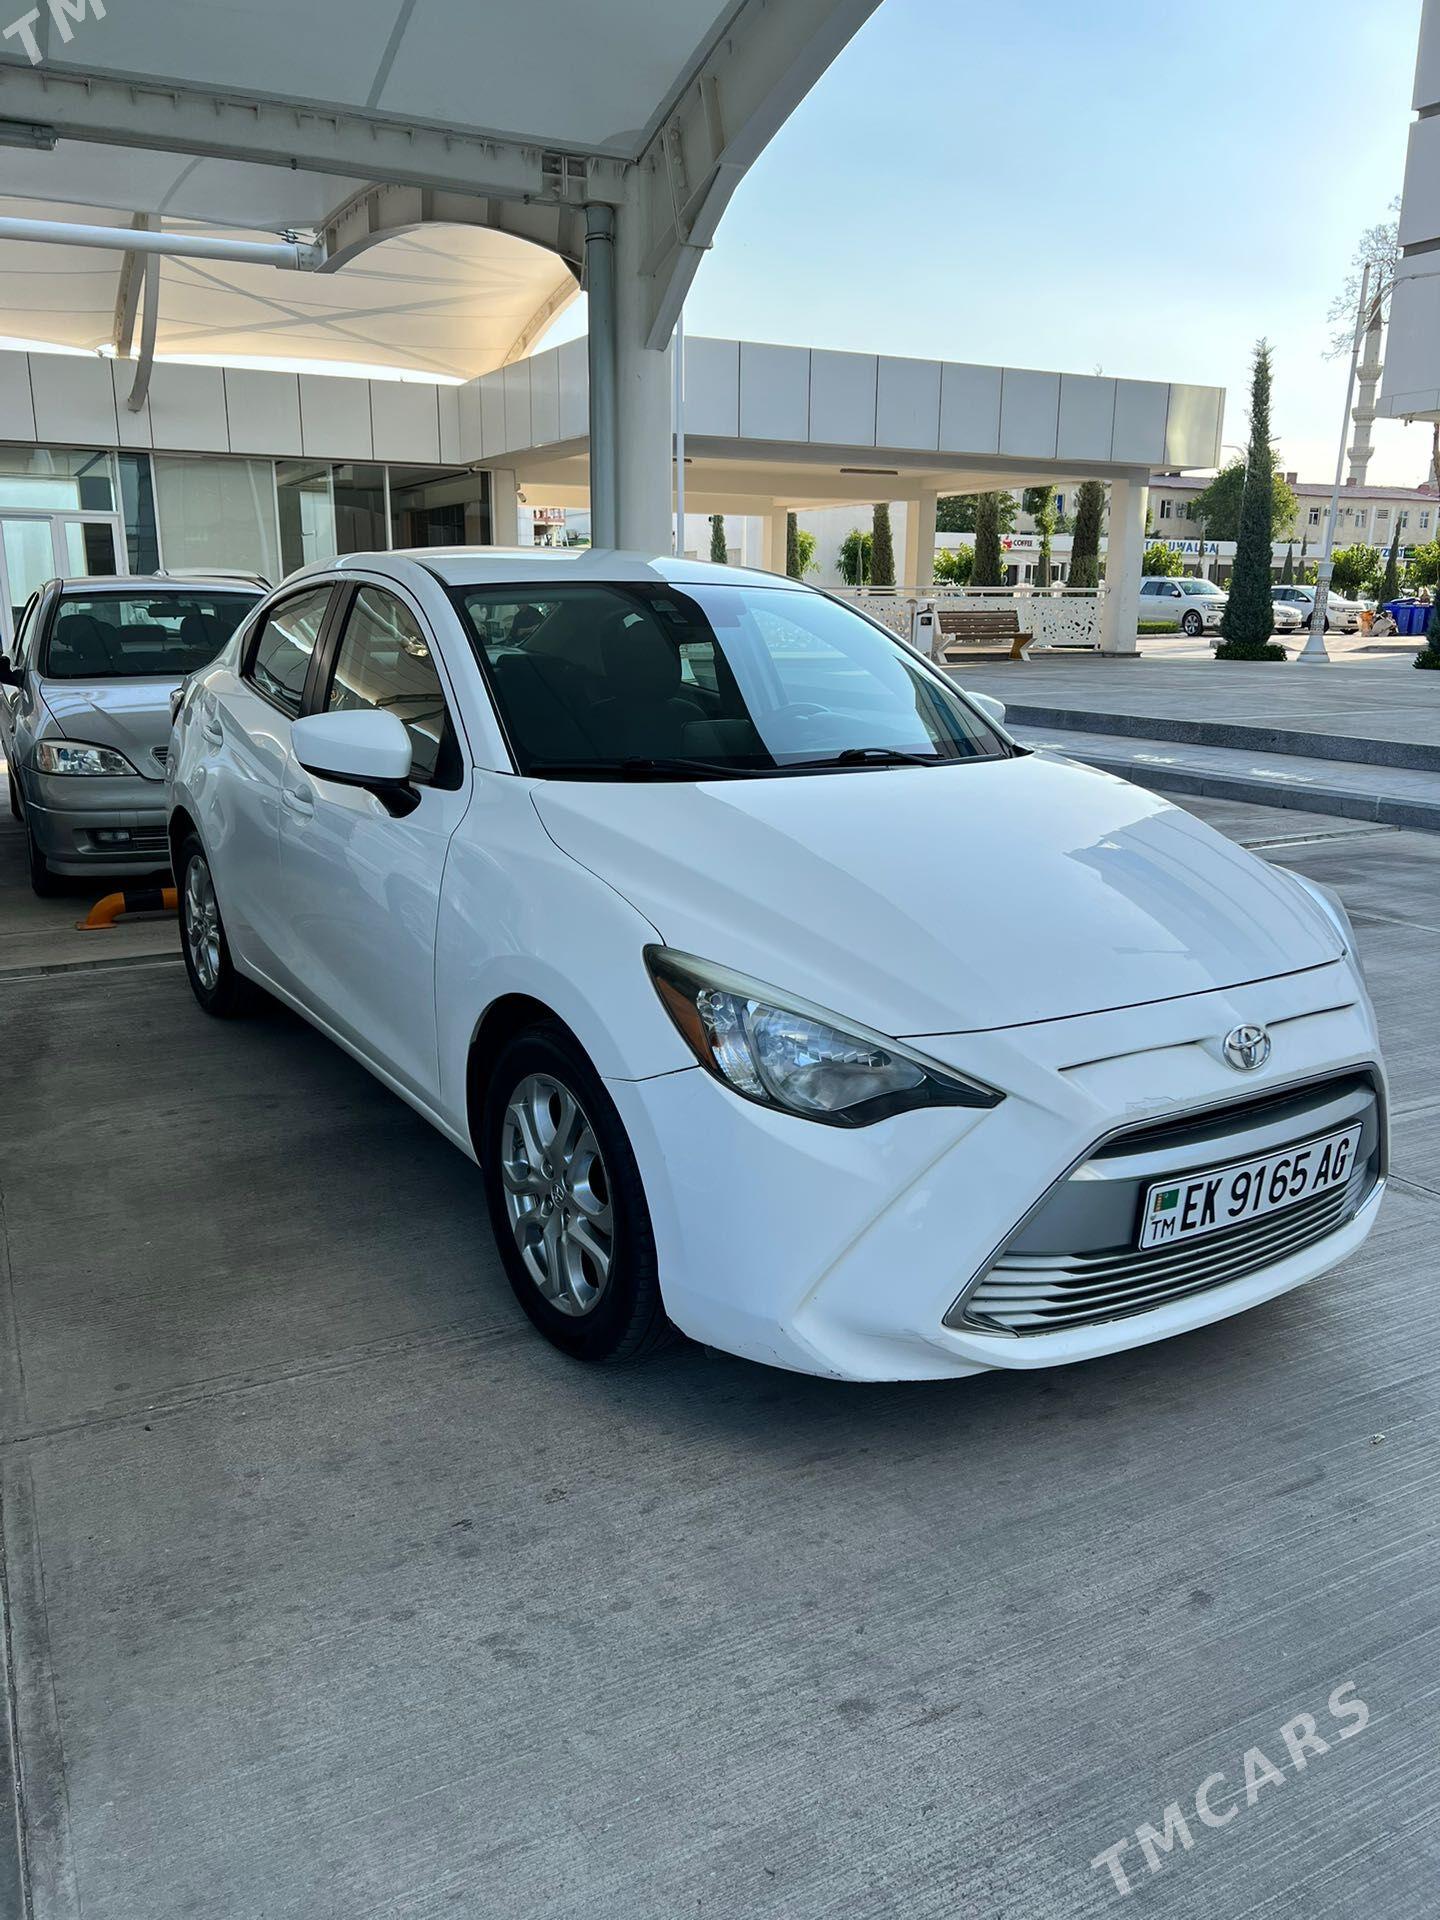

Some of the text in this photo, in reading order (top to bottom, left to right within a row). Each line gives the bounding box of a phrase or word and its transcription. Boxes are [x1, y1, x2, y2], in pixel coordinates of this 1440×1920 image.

[1180, 1137, 1350, 1233] EK 9165 AG
[1151, 1216, 1176, 1241] TM
